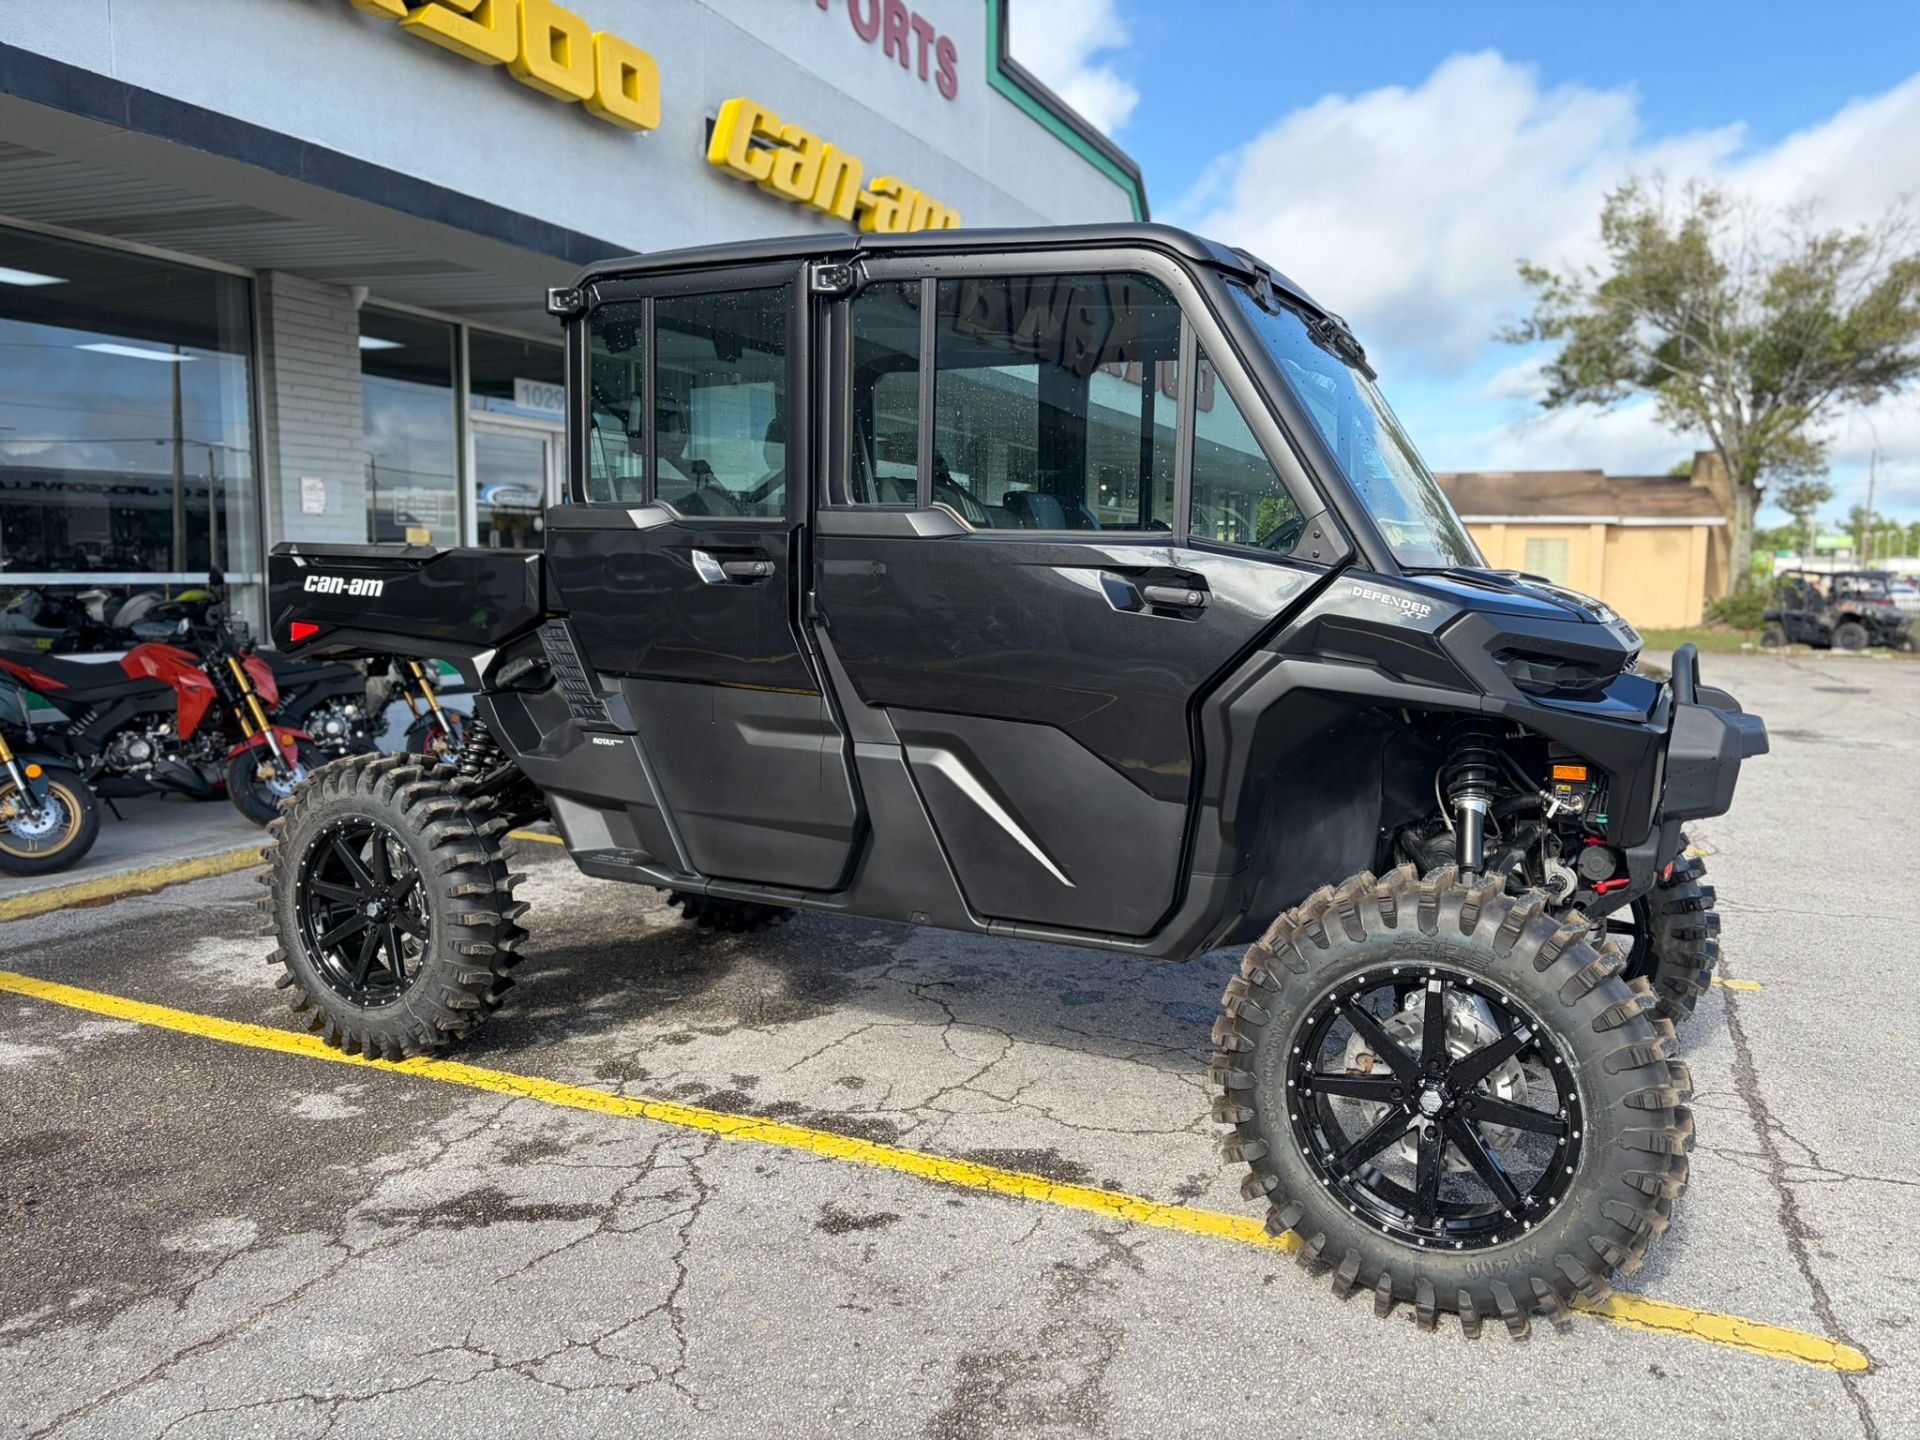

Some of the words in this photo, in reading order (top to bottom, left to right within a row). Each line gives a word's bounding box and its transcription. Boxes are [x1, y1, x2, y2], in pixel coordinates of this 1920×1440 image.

[816, 0, 958, 101] ORTS
[304, 575, 384, 597] can-am
[1352, 586, 1431, 614] DEFENDER
[1400, 610, 1427, 620] XT
[593, 737, 615, 746] ROTAX
